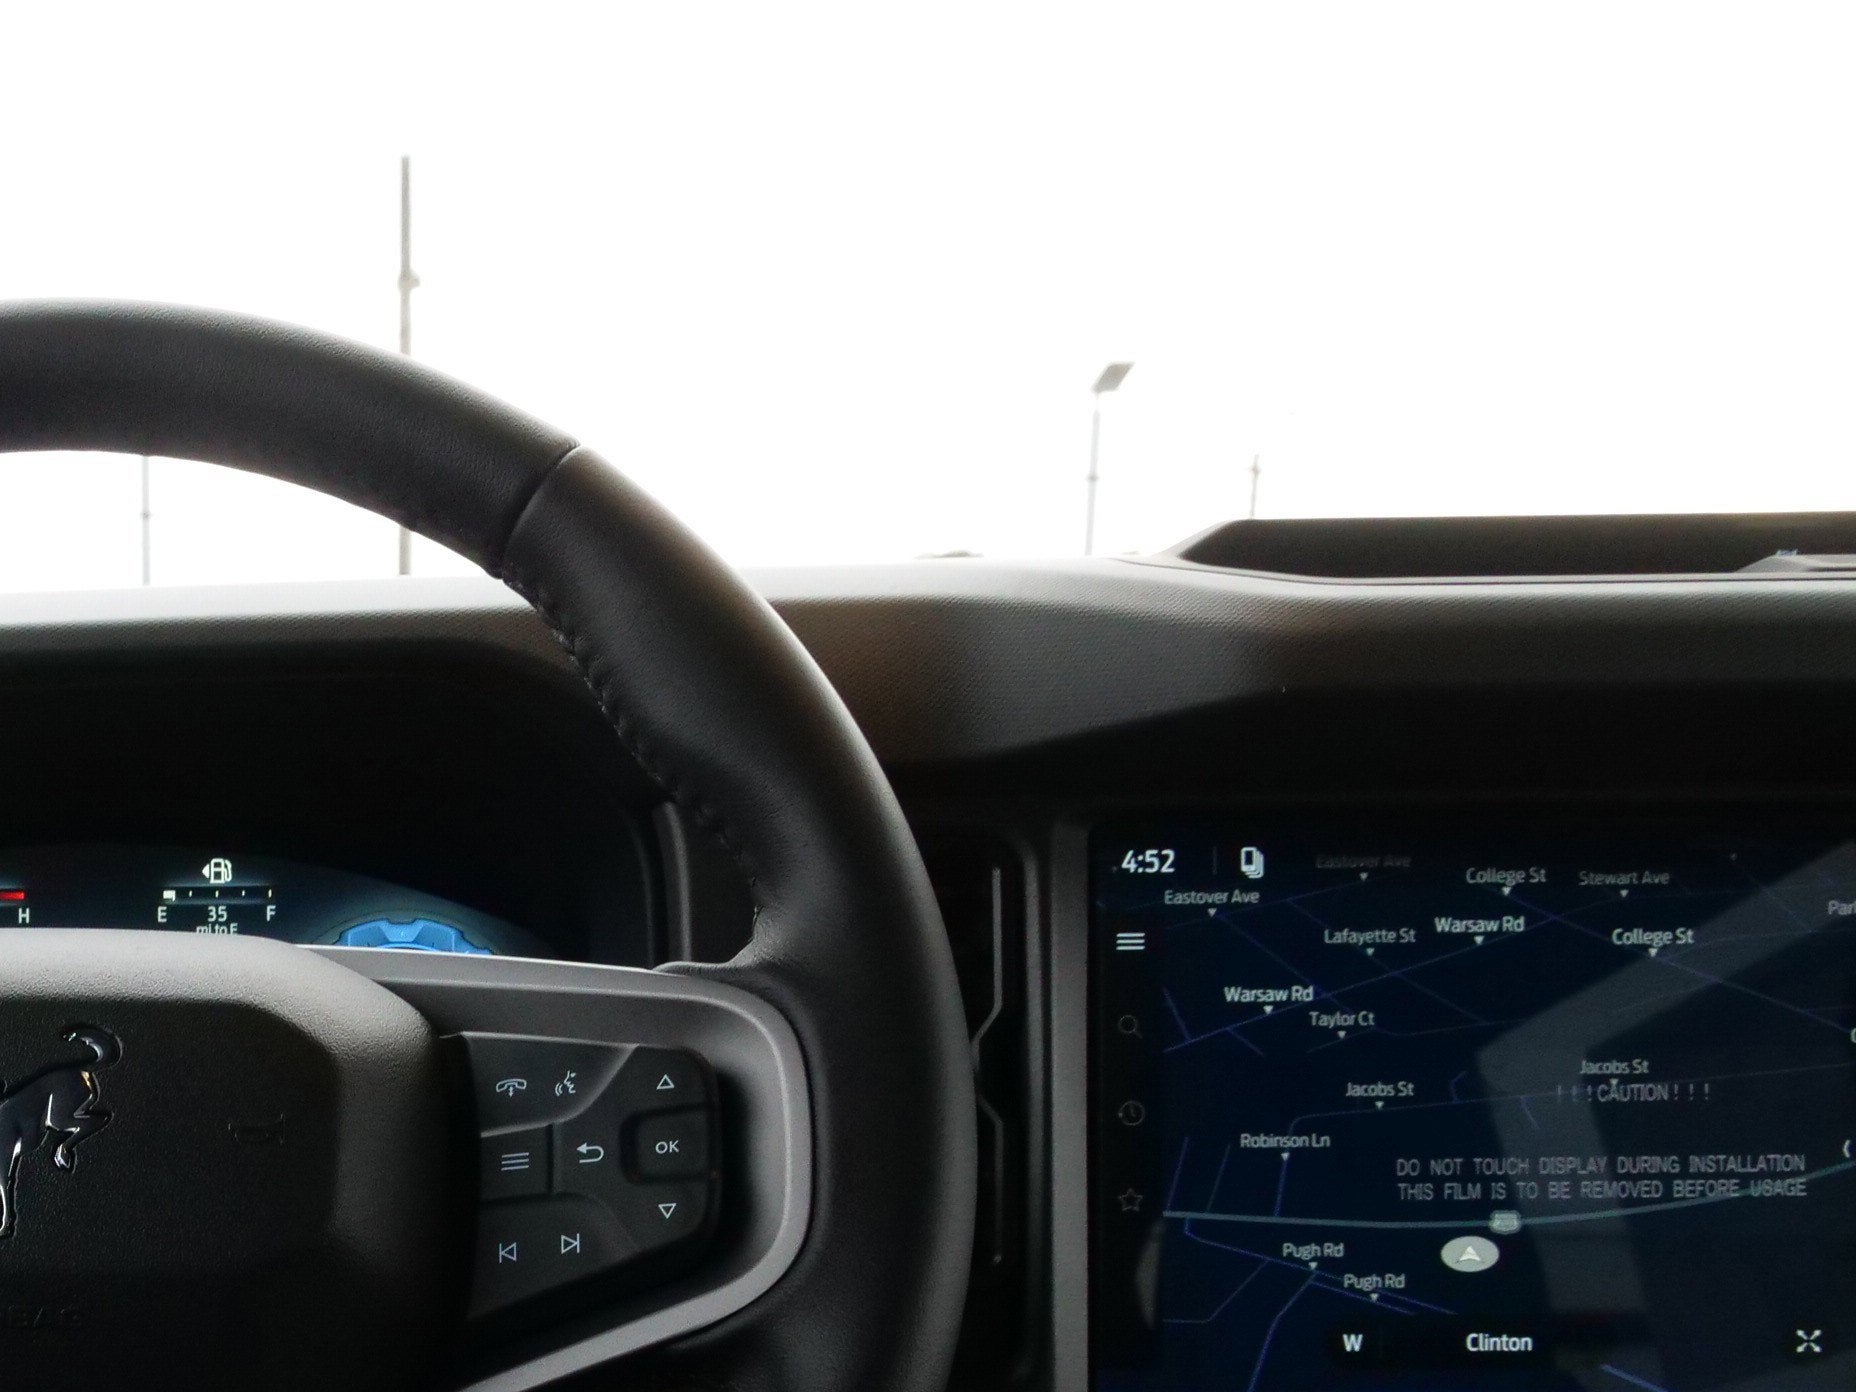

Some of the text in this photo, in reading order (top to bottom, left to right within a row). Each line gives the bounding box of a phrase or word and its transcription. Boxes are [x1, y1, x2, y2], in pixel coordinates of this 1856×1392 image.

[1121, 848, 1176, 874] 4:52
[1466, 866, 1547, 885] College St
[1578, 870, 1671, 886] Stewart Ave
[1164, 889, 1261, 905] Eastover Ave
[18, 907, 30, 924] H
[157, 906, 167, 923] E
[207, 905, 228, 922] 35
[266, 904, 276, 921] F
[1433, 915, 1525, 933] Warsaw Rd
[1324, 928, 1417, 946] Lafayette St
[1611, 927, 1694, 947] College St
[1224, 985, 1314, 1003] Warsaw Rd
[1308, 1011, 1376, 1029] Taylor Ct
[1579, 1058, 1650, 1076] Jacobs St
[1345, 1080, 1415, 1098] Jacobs St
[655, 1140, 680, 1155] OK
[1240, 1133, 1331, 1149] Robinson Ln
[1396, 1153, 1805, 1177] DO NOT TOUCH DISPLAY DURING INSTALLATION
[1396, 1178, 1808, 1201] THIS FILM IS TO BE REMOVED BEFORE USAGE
[1282, 1242, 1344, 1261] Pugh Rd
[1343, 1273, 1405, 1292] Pugh Rd
[1342, 1333, 1364, 1352] W
[1466, 1333, 1534, 1352] Clinton
